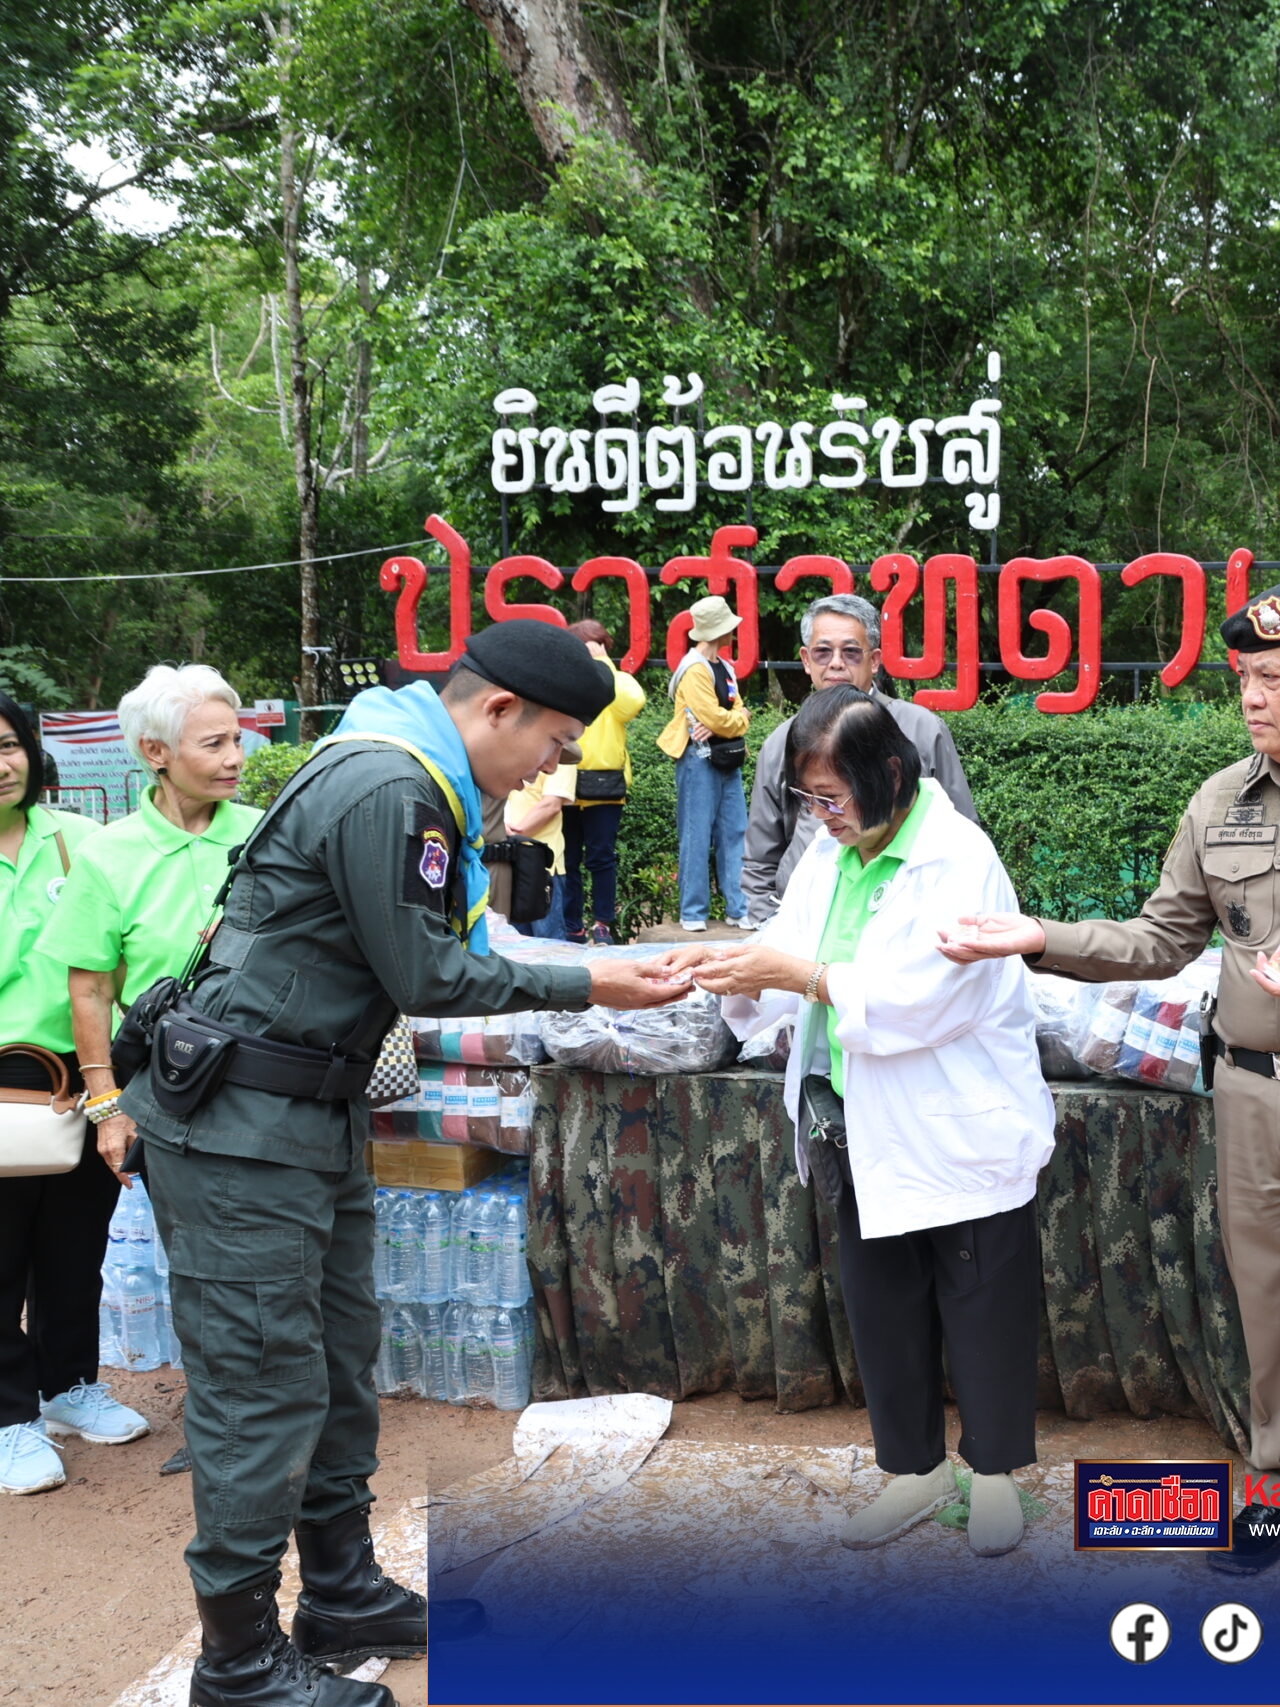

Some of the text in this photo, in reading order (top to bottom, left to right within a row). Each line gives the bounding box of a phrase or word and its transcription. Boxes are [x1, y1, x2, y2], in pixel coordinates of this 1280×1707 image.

[491, 351, 1002, 530] ยินดีต้อนรับสู่
[174, 1040, 195, 1054] POLICE
